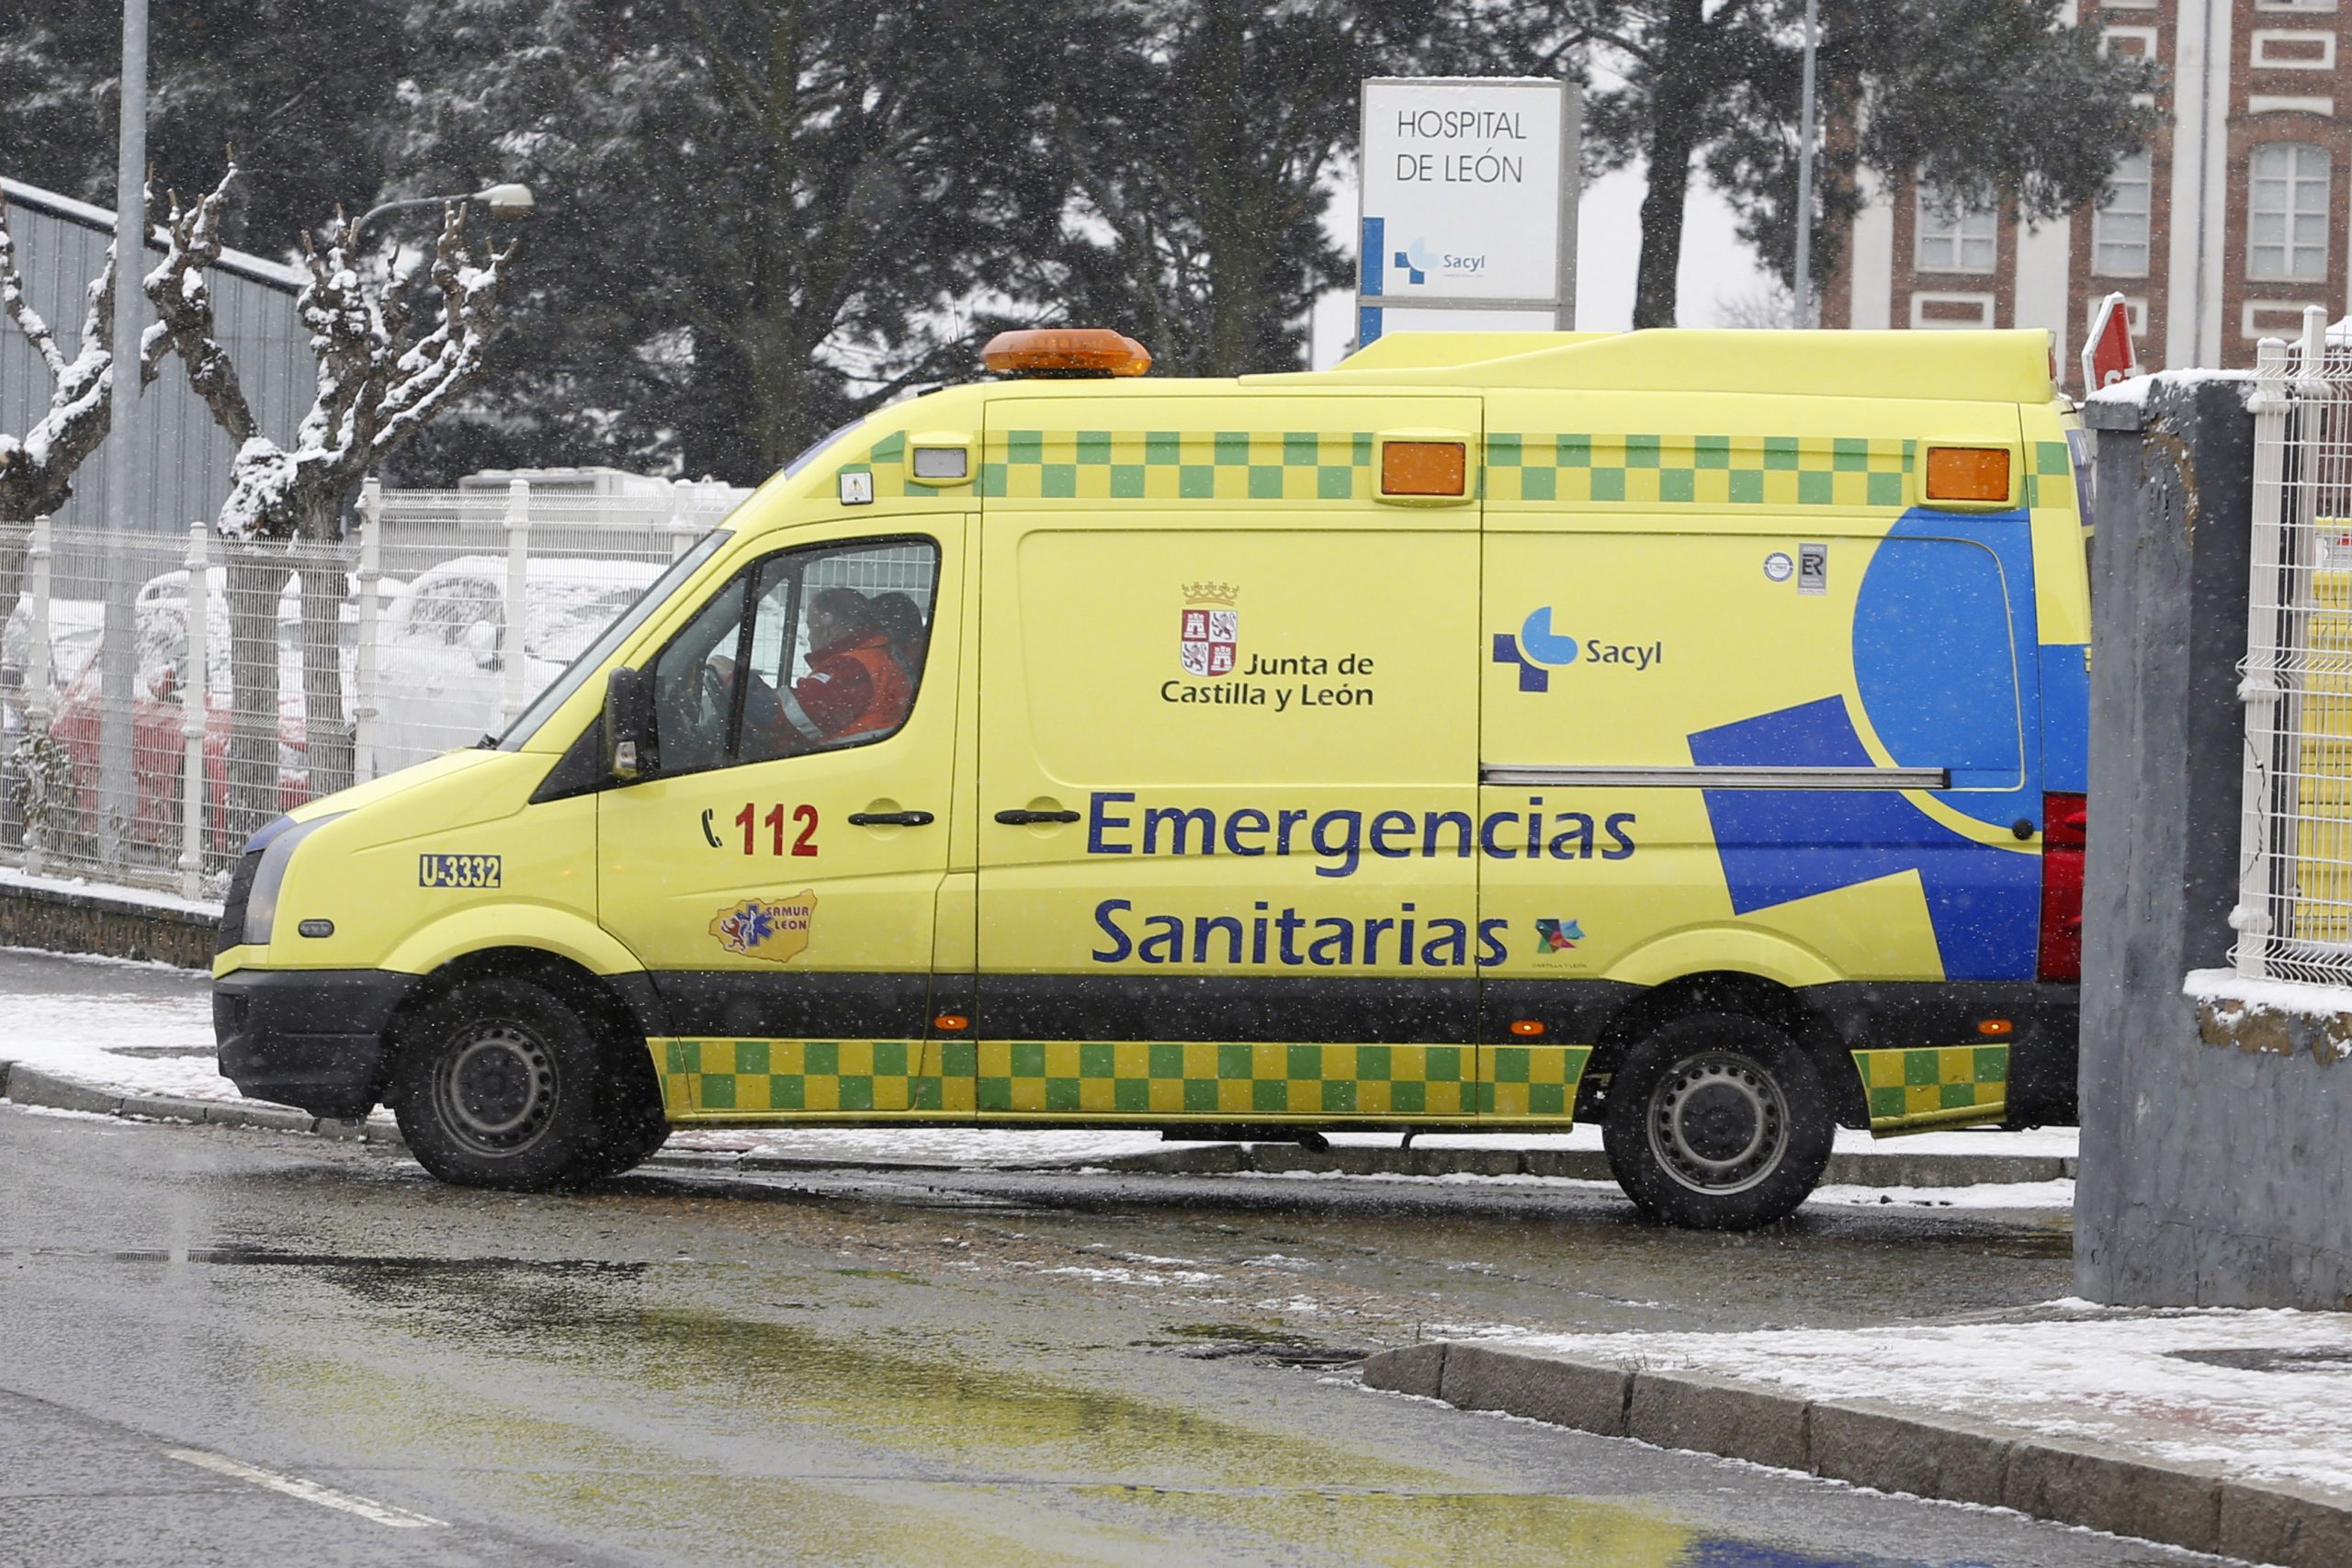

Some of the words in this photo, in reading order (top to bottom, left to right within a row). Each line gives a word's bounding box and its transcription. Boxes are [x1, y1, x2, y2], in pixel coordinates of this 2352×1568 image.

[1397, 110, 1527, 140] HOSPITAL
[1396, 154, 1433, 181] DE
[1445, 147, 1522, 183] LEÓN
[1443, 254, 1485, 272] Sacyl
[1244, 654, 1328, 675] Junta
[1338, 653, 1374, 675] de
[1587, 640, 1661, 671] Sacyl
[1160, 681, 1265, 705] Castilla
[1274, 689, 1293, 712] y
[1301, 684, 1374, 705] León
[735, 803, 819, 857] 112
[1087, 793, 1636, 878] Emergencias
[423, 856, 499, 886] U-3332
[765, 906, 808, 917] SAMUR
[775, 920, 807, 931] LEON
[1091, 899, 1510, 967] Sanitarias
